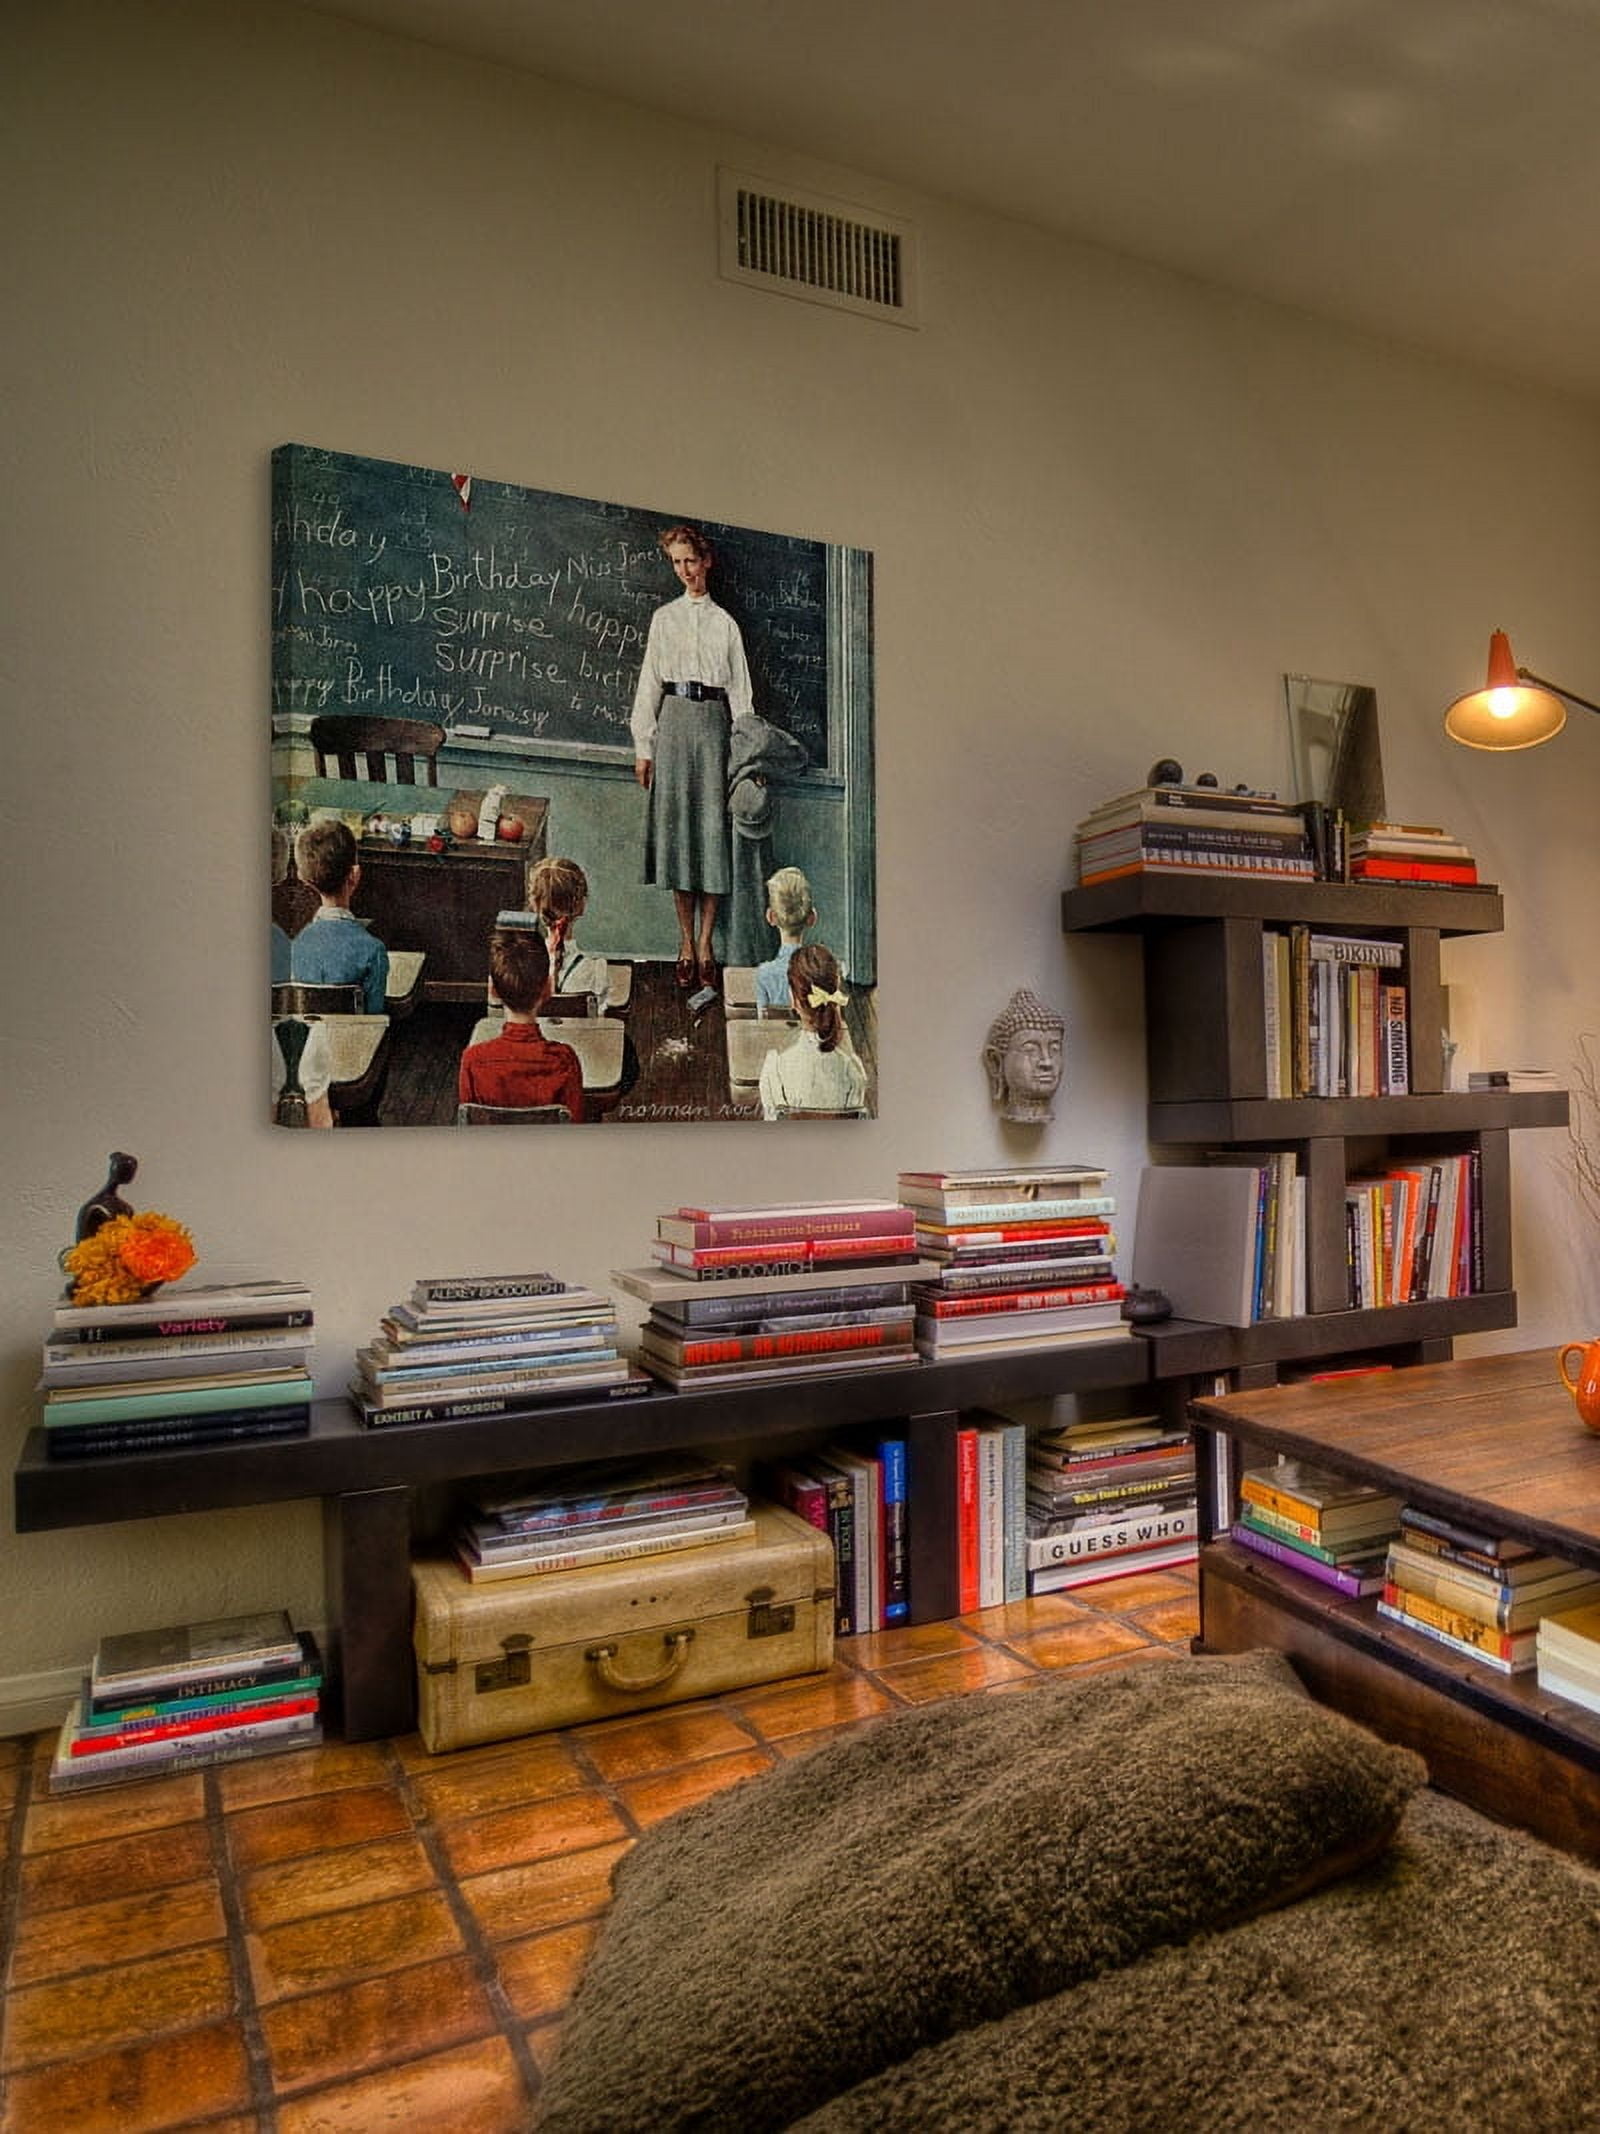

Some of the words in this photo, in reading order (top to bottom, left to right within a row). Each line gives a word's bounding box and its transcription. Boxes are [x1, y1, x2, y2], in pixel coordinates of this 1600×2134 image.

[297, 568, 426, 625] happy
[428, 545, 561, 606] Birthday
[434, 642, 567, 681] Surprise
[342, 655, 465, 723] Birthday
[159, 1317, 228, 1336] Variety
[1051, 1530, 1130, 1560] GUESS
[1136, 1519, 1186, 1541] WHO
[177, 1676, 258, 1698] INTIMACY
